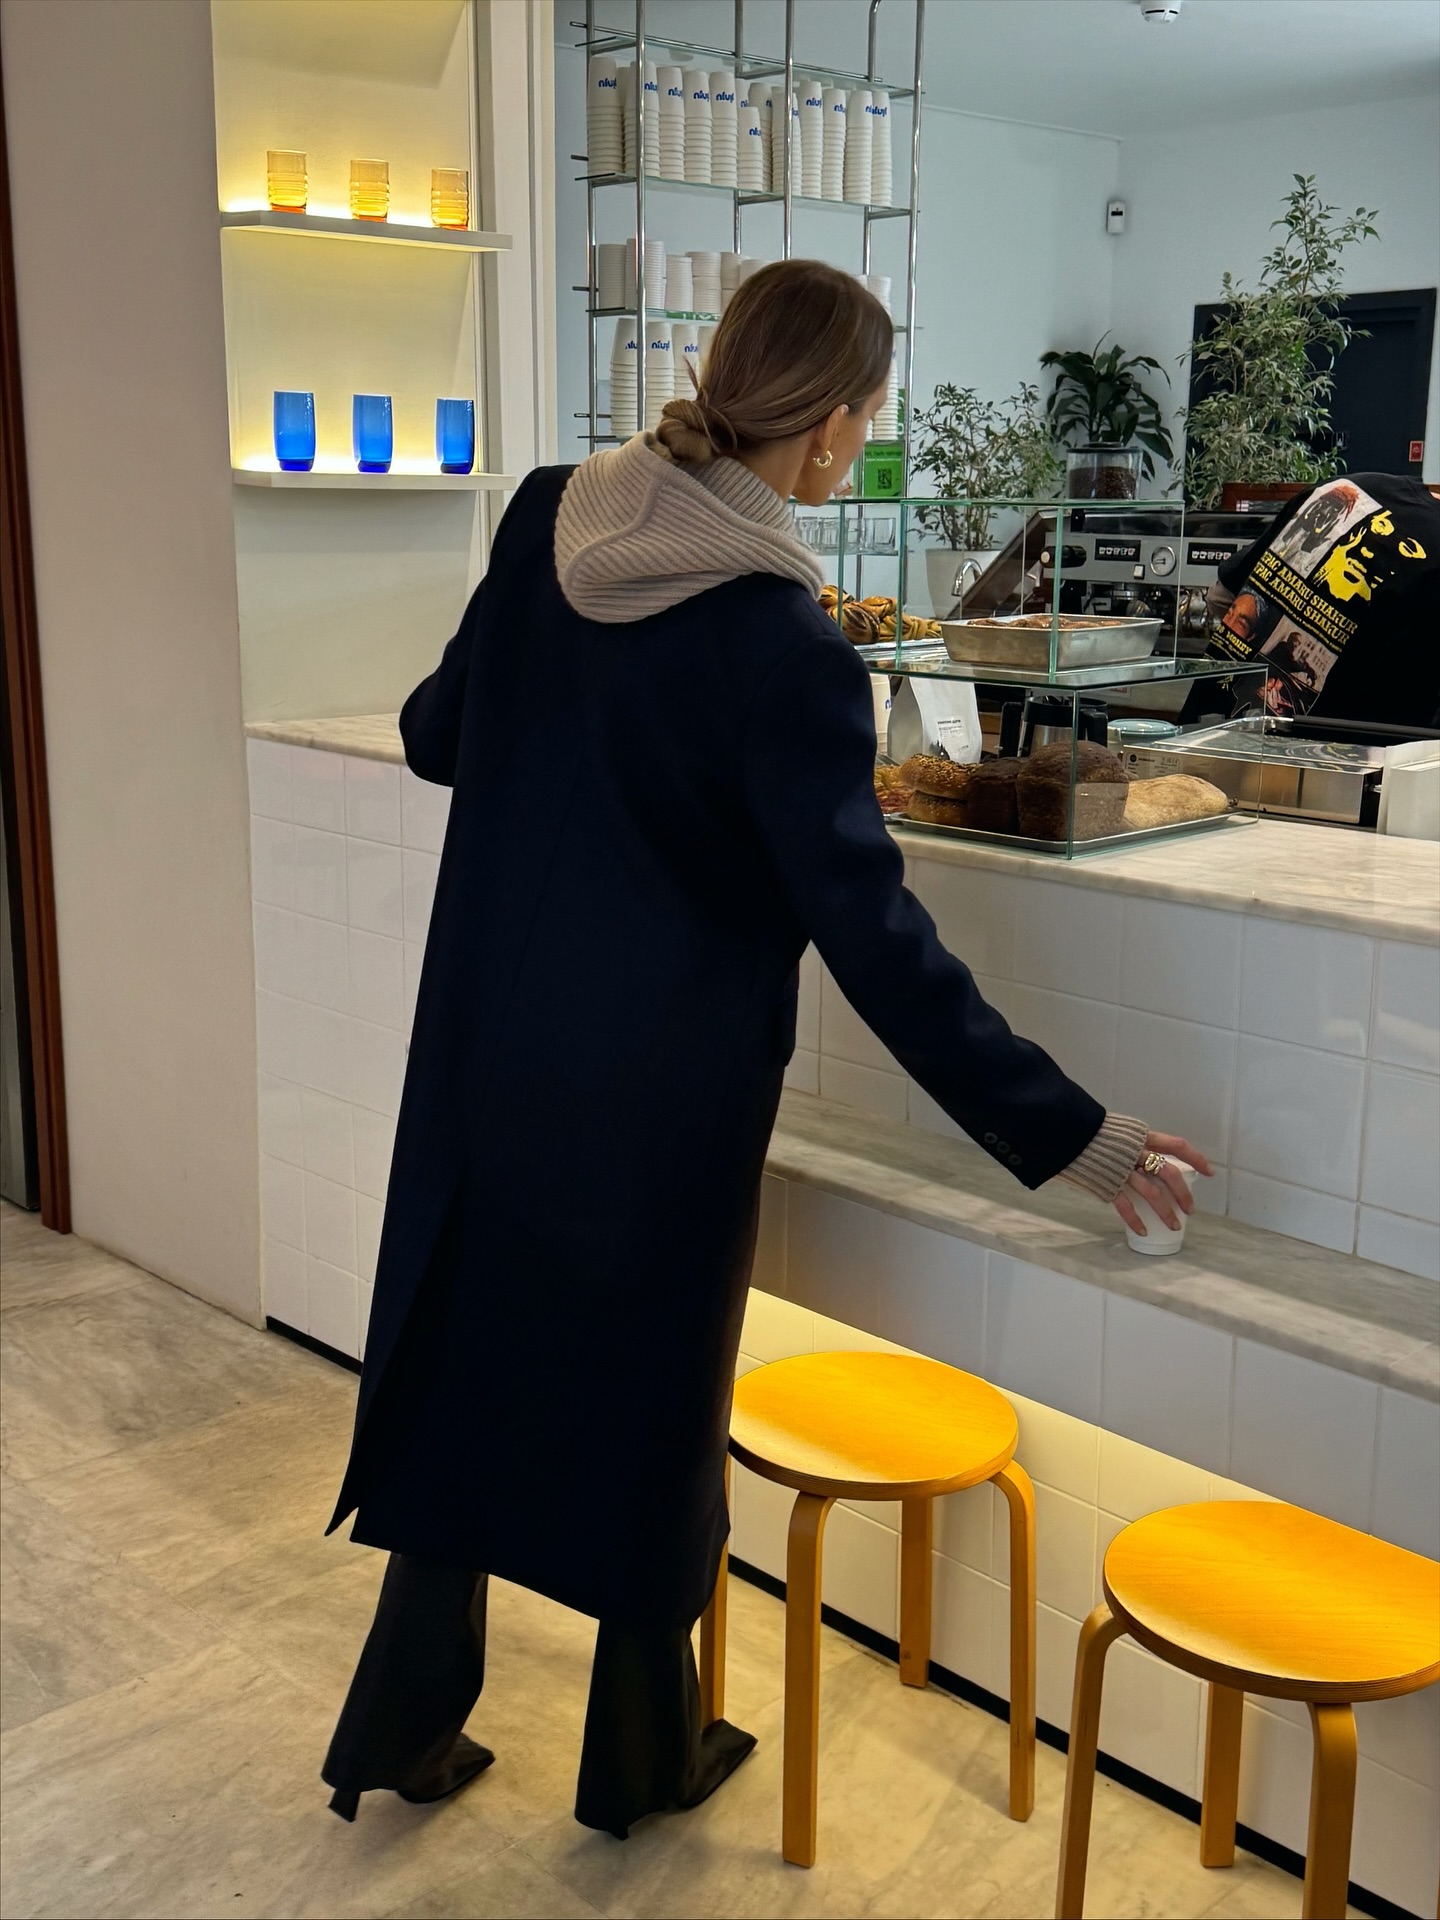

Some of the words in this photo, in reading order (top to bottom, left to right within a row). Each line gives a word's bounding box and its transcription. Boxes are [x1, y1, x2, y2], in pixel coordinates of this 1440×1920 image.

[716, 91, 734, 103] jinju
[651, 340, 670, 351] jinju
[1267, 576, 1308, 612] AMARU
[1276, 566, 1314, 600] AMARU
